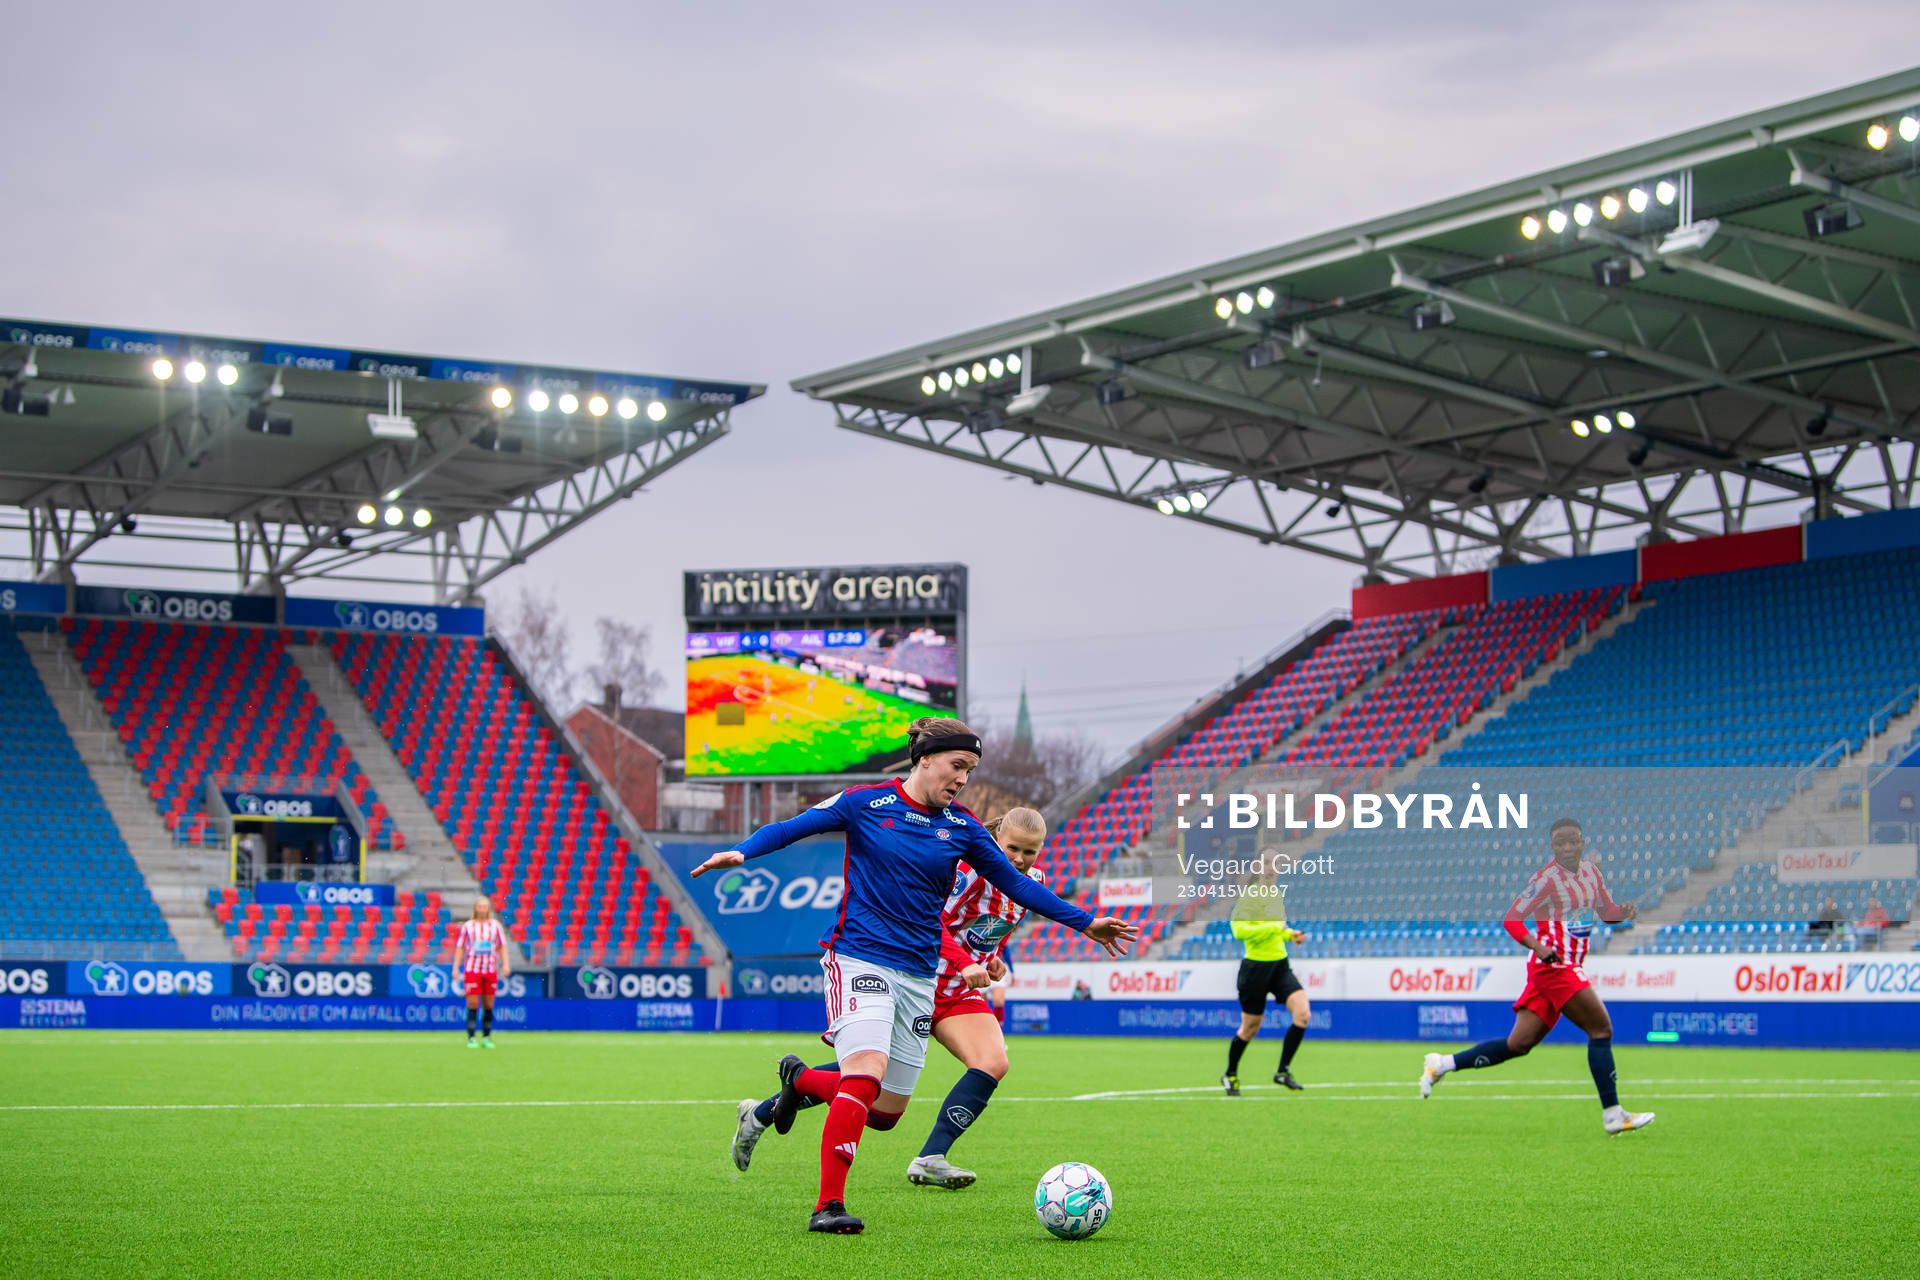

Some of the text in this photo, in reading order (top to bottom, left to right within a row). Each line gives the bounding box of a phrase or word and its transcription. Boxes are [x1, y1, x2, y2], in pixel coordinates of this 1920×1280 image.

[33, 333, 74, 348] OBOS
[123, 340, 164, 354] OBOS
[296, 356, 336, 370] OBOS
[380, 363, 418, 377] OBOS
[700, 391, 736, 403] OBOS
[701, 570, 940, 610] intility arena
[164, 597, 233, 621] OBOS
[372, 608, 438, 633] OBOS
[716, 636, 737, 647] VIF
[263, 800, 313, 816] OBOS
[869, 793, 897, 809] coop
[911, 812, 931, 824] STENA
[942, 807, 967, 826] coop
[1782, 852, 1849, 871] OsloTaxi
[324, 887, 374, 904] OBOS
[132, 970, 214, 995] OBOS
[293, 971, 372, 997] OBOS
[450, 974, 527, 998] OOS
[620, 974, 693, 998] OBOS
[856, 978, 886, 990] ooni
[1108, 971, 1179, 993] OsloTaxi
[1389, 967, 1474, 993] OsloTaxi
[1734, 962, 1920, 994] OsloTaxi 0232
[37, 1000, 86, 1015] STENA
[650, 1002, 694, 1017] STENA
[848, 996, 858, 1012] 8
[917, 1020, 932, 1032] oo
